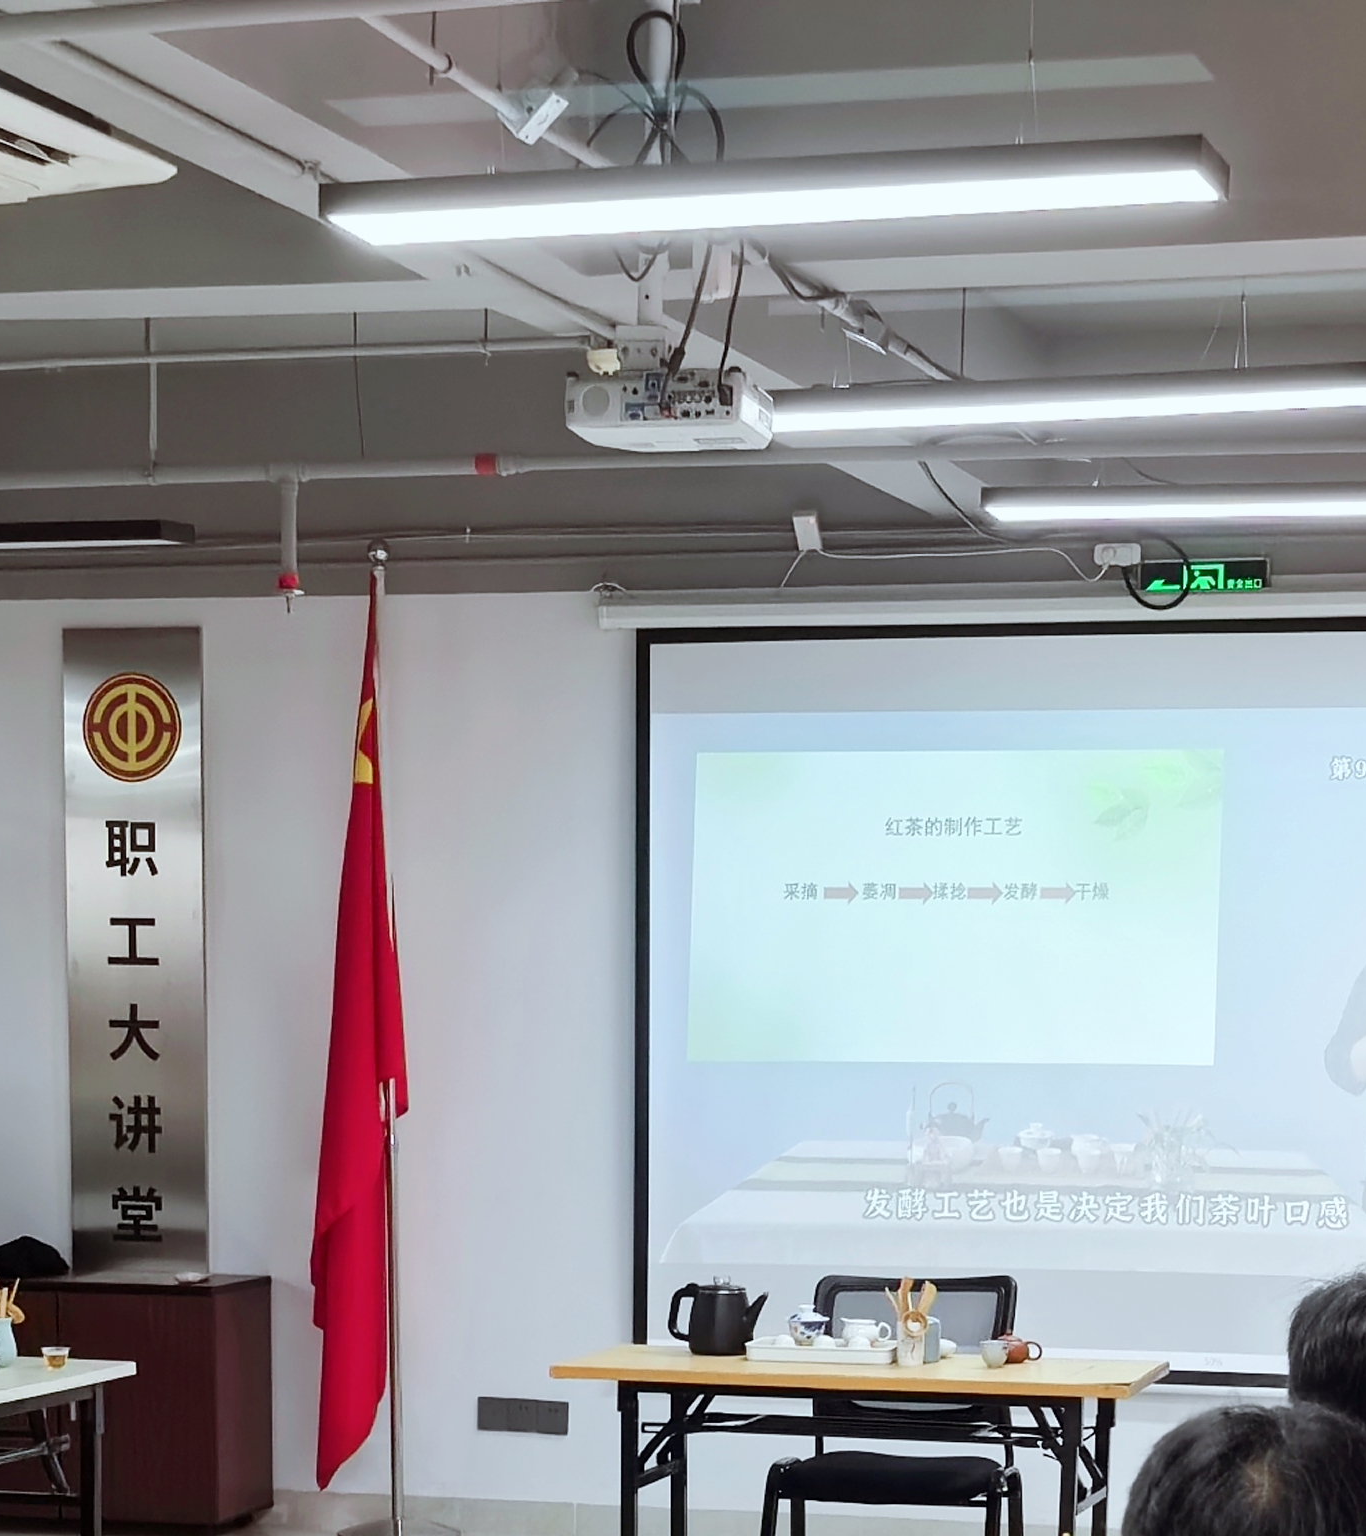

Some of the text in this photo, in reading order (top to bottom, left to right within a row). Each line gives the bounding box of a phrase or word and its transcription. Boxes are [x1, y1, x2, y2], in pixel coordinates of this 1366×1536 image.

[884, 816, 1023, 838] 红茶的制作工艺
[783, 881, 1110, 901] 采摘 萎凋 揉捻 发酵 干燥
[104, 819, 163, 1244] 职工大讲堂
[861, 1187, 1351, 1230] 发酵工艺也是决定我们茶叶口感
